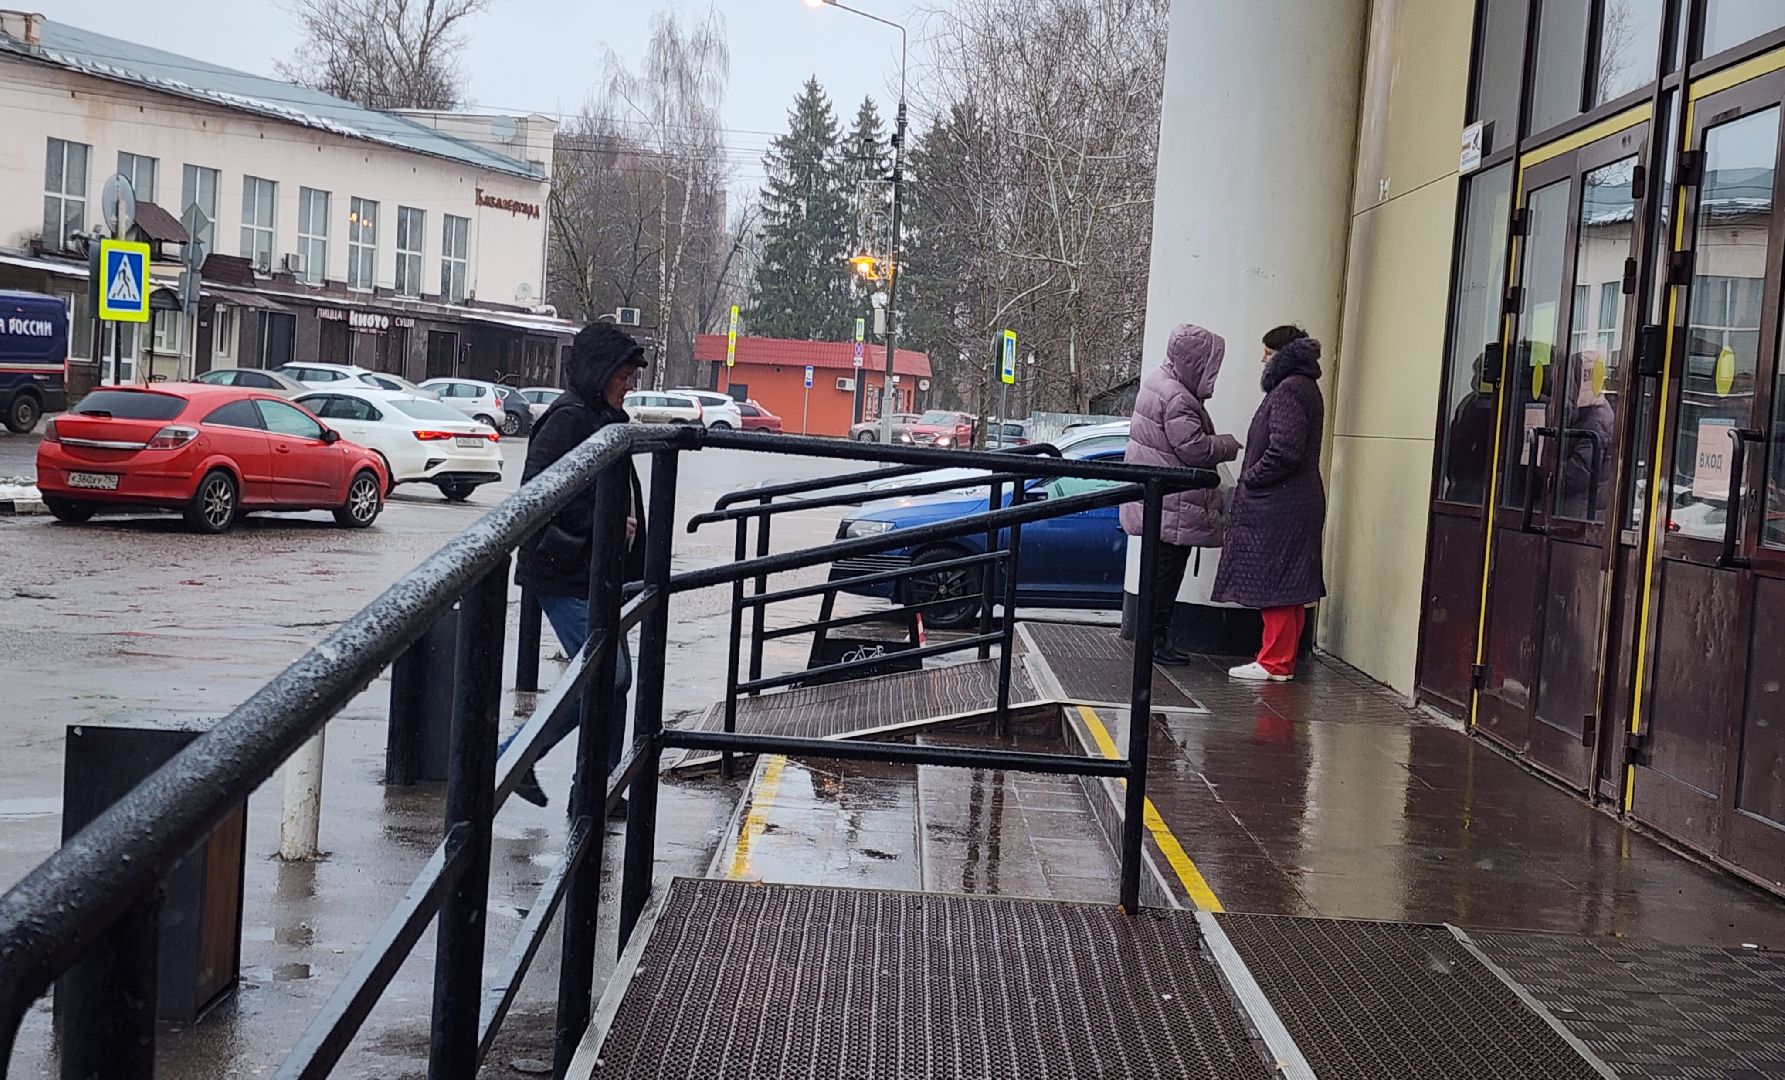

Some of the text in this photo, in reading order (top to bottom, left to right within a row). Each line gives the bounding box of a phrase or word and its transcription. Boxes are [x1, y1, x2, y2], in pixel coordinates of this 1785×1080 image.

[9, 318, 53, 336] РОССИИ
[316, 308, 342, 320] ПИЦЦА
[395, 317, 415, 328] СУШИ
[1700, 452, 1723, 472] ВХОД
